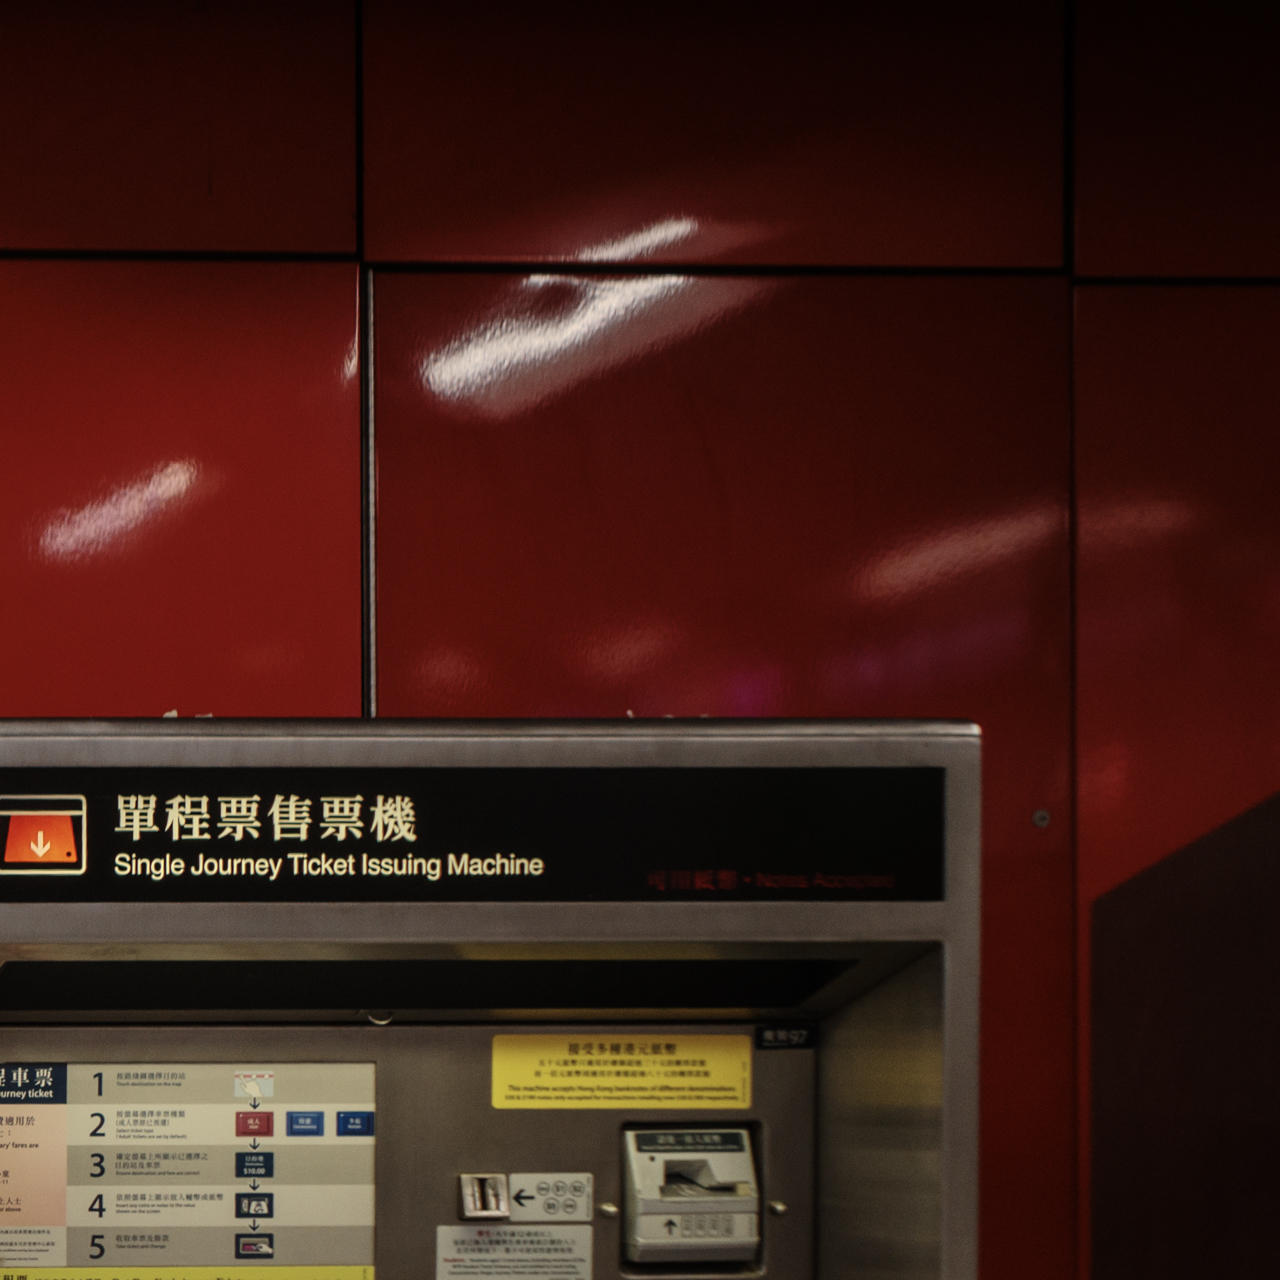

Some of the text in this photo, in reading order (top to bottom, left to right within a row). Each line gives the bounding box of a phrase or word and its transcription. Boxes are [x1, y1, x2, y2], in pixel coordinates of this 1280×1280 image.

[114, 795, 416, 842] 單程票售票機
[114, 853, 544, 880] Single Journey Ticket Issuing Machine
[28, 1089, 53, 1097] ticket
[92, 1072, 103, 1096] 1
[89, 1113, 105, 1136] 2
[90, 1153, 105, 1177] 3
[88, 1194, 106, 1218] 4
[89, 1235, 105, 1259] 5
